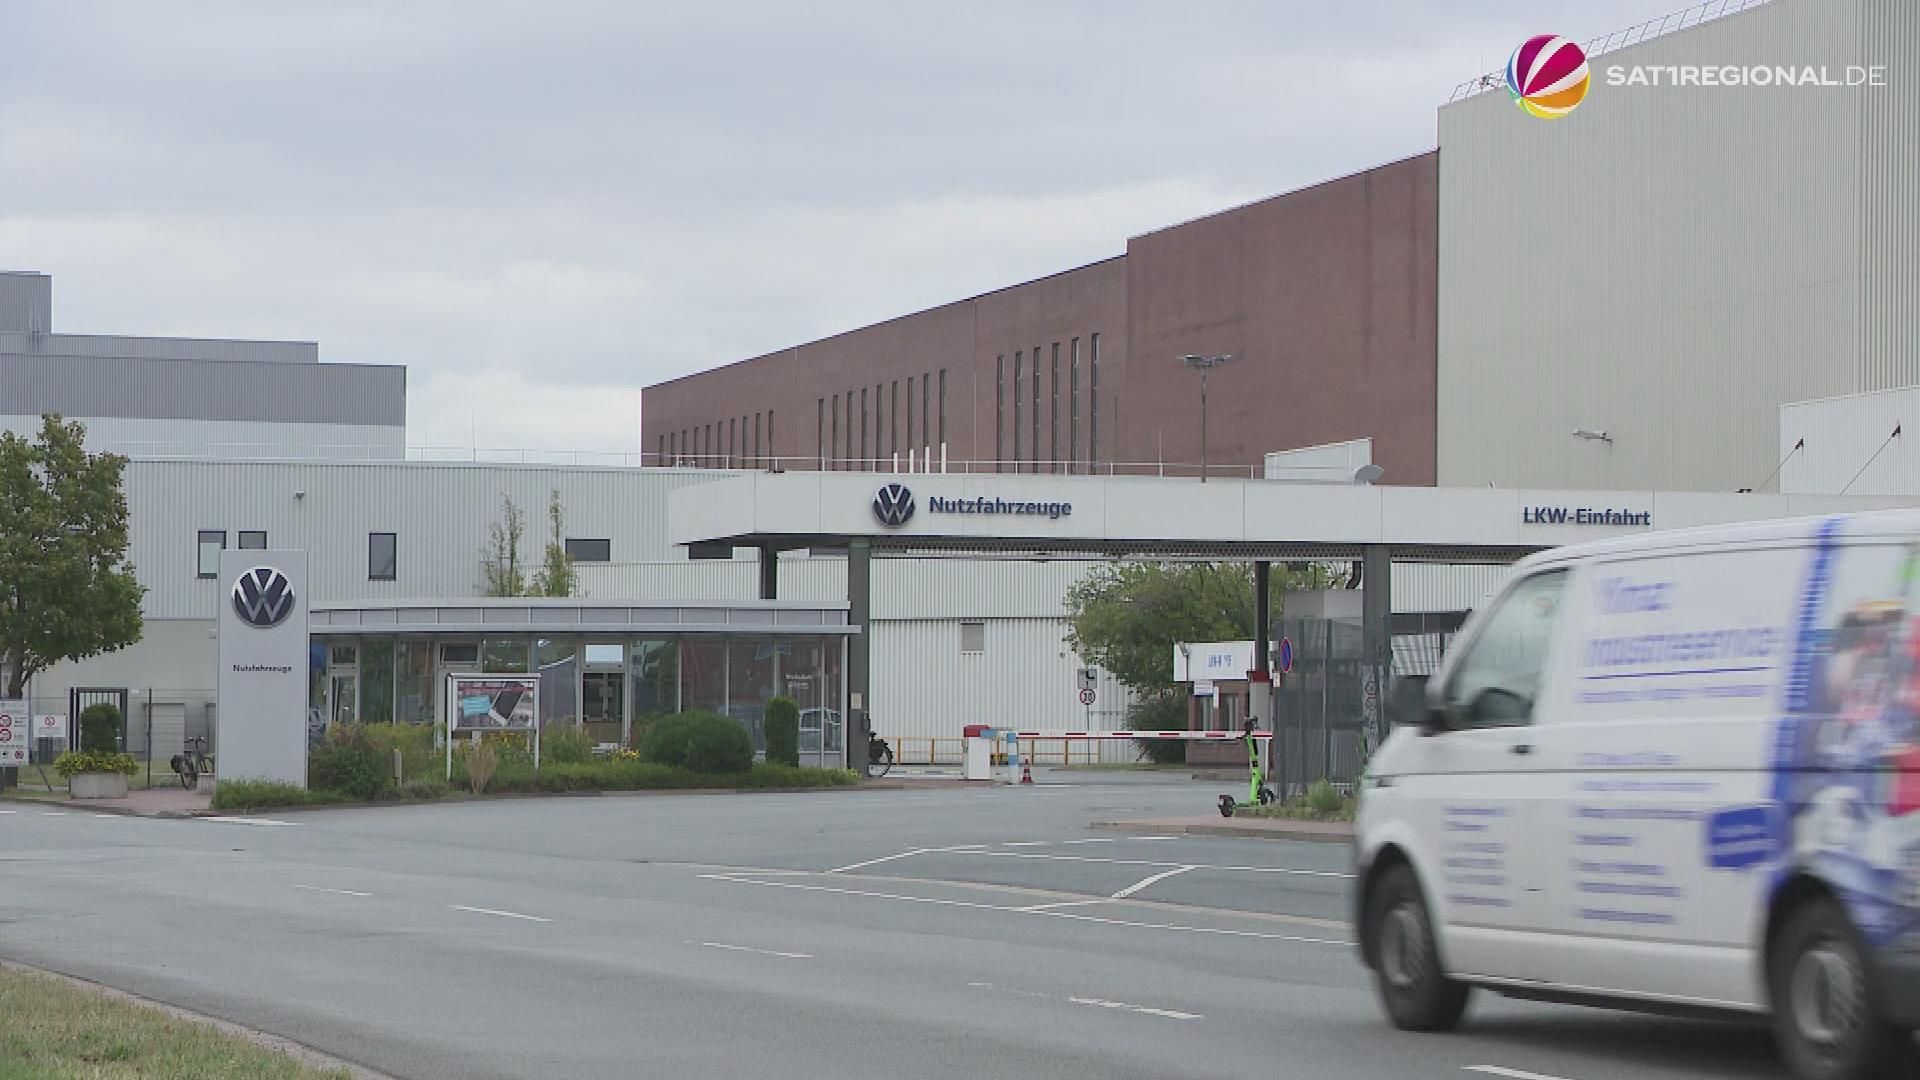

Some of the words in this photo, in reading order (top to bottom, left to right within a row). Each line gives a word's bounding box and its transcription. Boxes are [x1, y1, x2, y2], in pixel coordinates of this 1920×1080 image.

[929, 496, 1072, 520] Nutzfahrzeuge
[1523, 506, 1651, 526] LKW-Einfahrt
[233, 664, 293, 674] Nutzfahrzeuge
